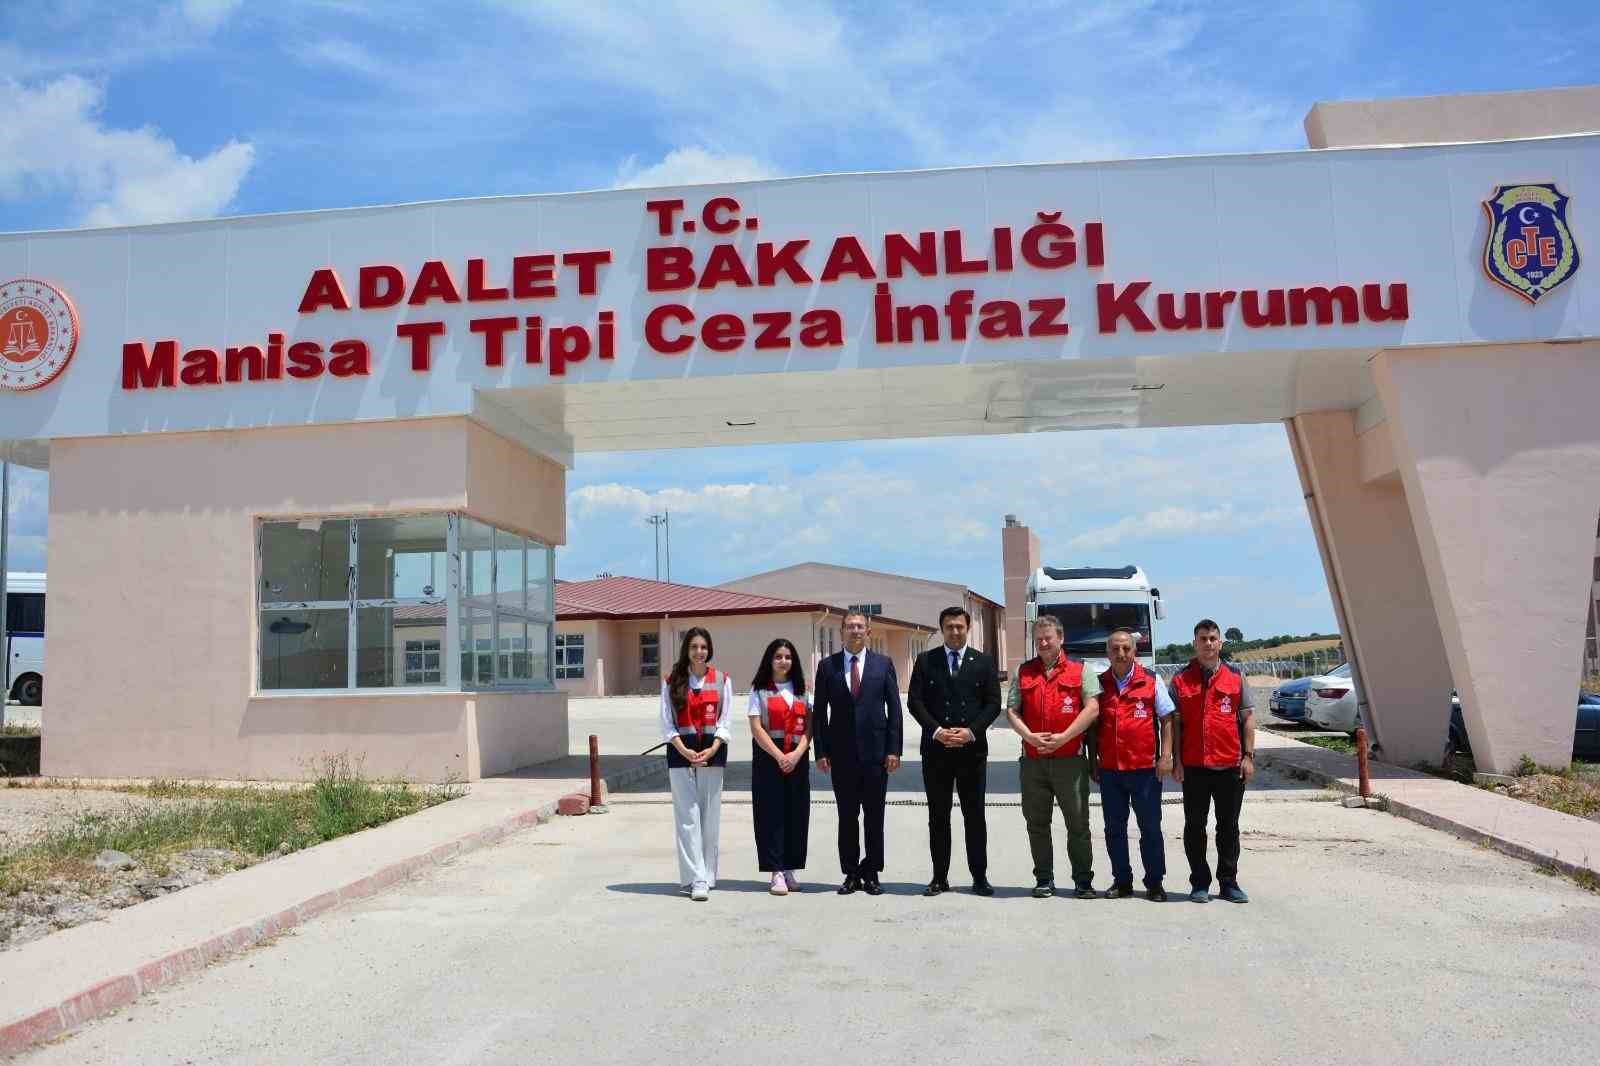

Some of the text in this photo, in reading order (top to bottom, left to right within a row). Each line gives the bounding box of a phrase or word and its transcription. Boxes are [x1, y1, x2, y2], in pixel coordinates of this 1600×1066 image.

[646, 197, 757, 236] T.C.
[1506, 226, 1557, 269] CTE
[298, 212, 1104, 314] ADALET BAKANLIĞI
[122, 281, 1409, 391] Manisa T Tipi Ceza İnfaz Kurumu
